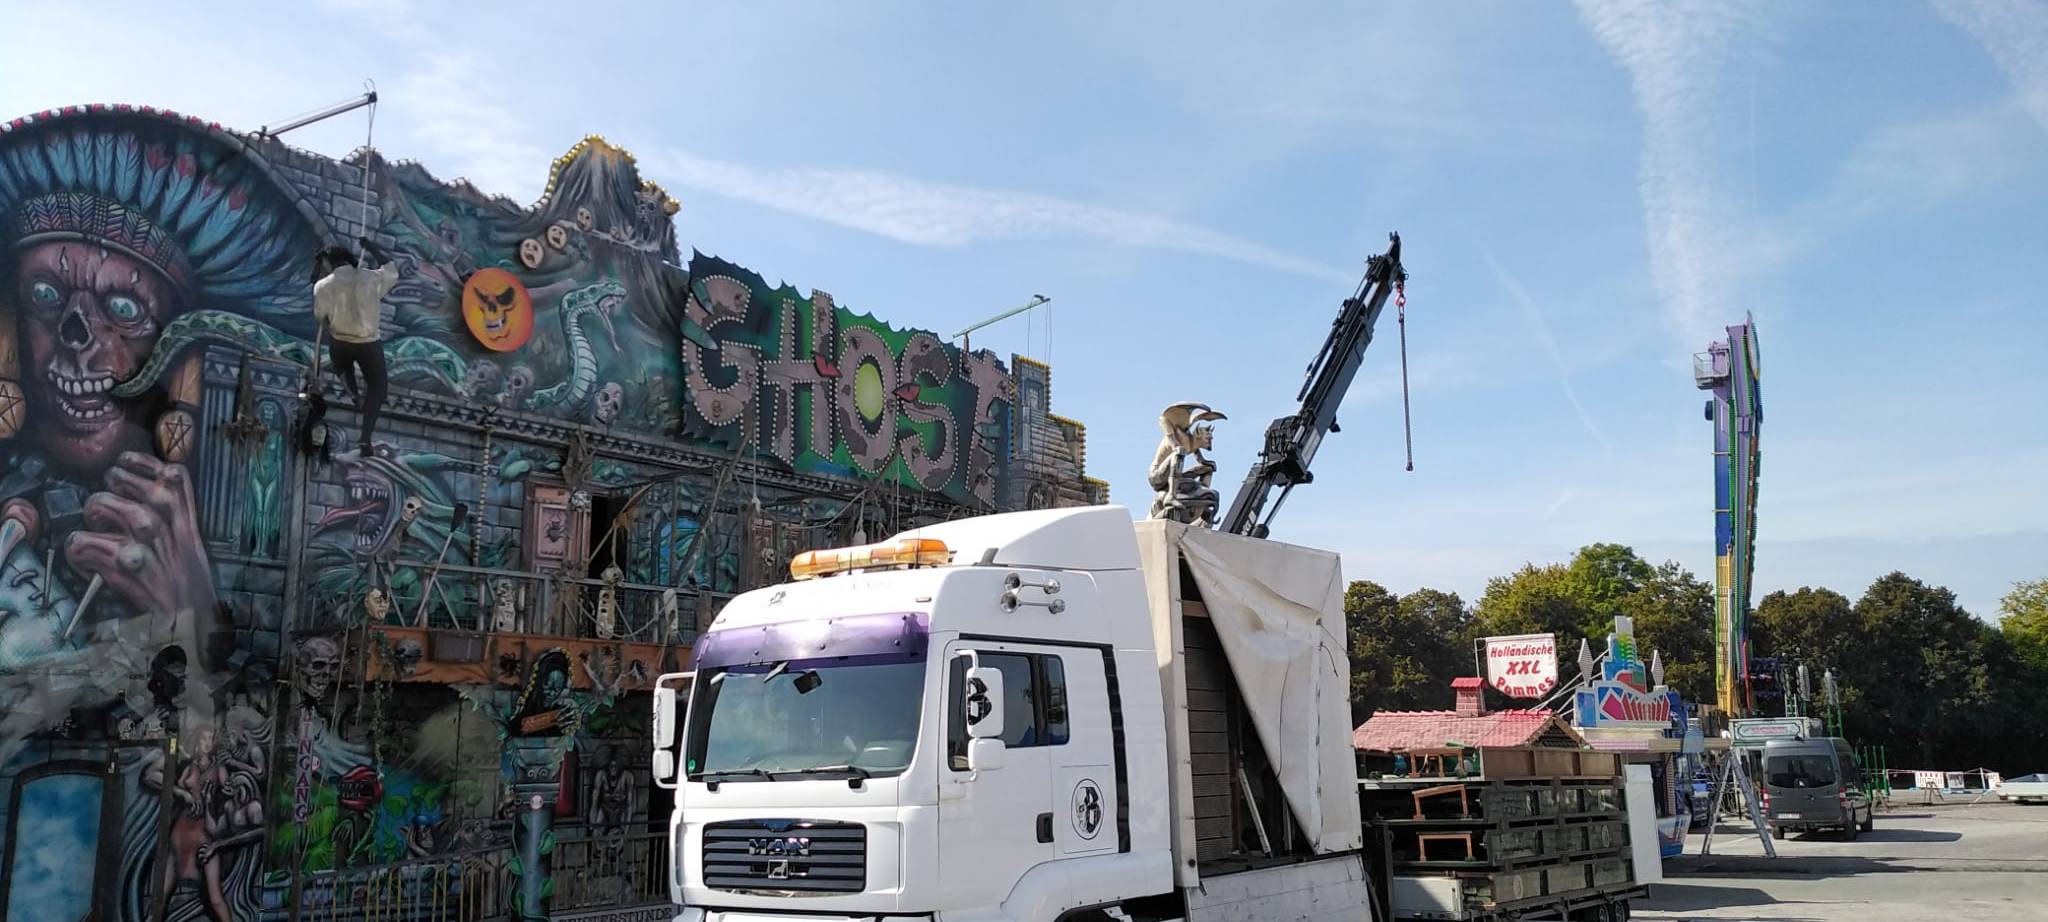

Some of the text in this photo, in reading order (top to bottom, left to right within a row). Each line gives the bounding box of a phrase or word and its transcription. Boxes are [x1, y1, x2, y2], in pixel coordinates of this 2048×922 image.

[682, 273, 1013, 508] GHOST
[1491, 644, 1553, 658] Holländische
[1506, 660, 1541, 675] XXL
[1496, 676, 1554, 696] Pommes
[749, 837, 809, 855] MAN
